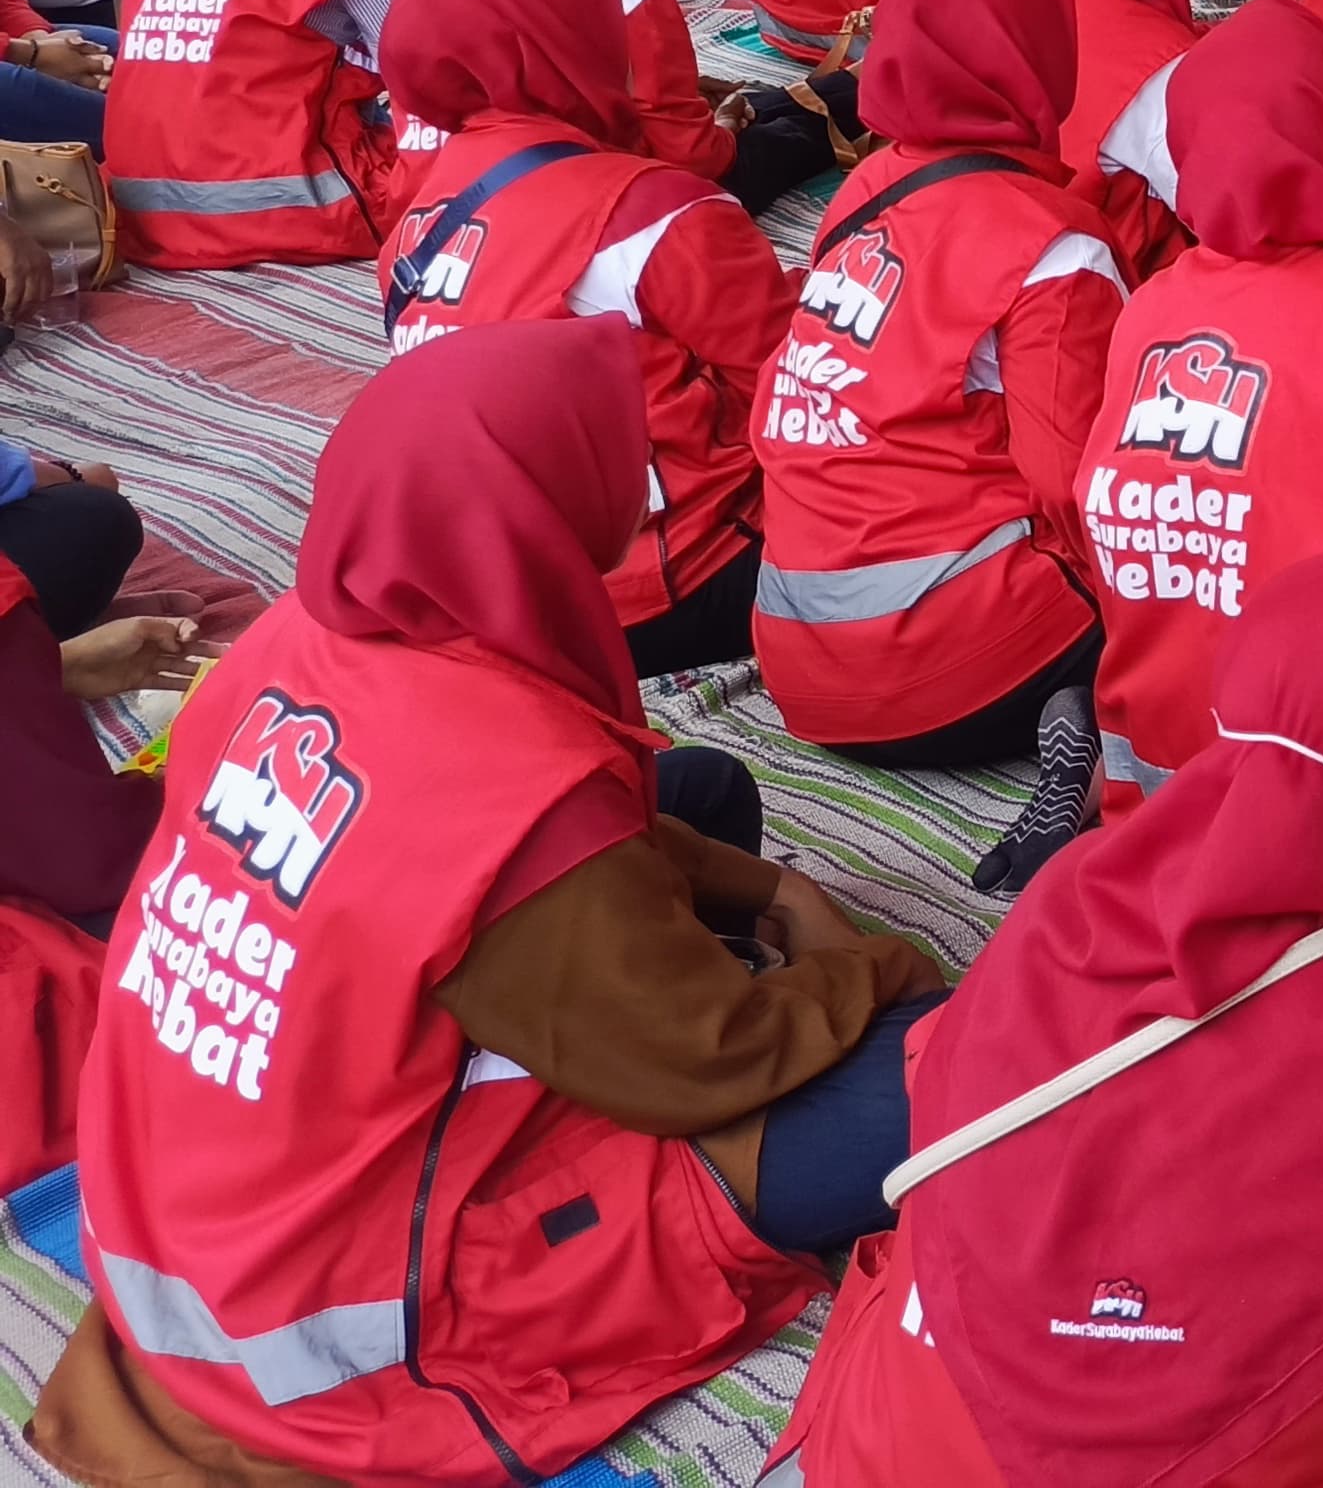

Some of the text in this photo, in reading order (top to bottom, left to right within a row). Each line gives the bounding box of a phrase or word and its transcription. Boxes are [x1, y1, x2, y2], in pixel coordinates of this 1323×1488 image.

[777, 327, 868, 392] ader
[1085, 467, 1251, 532] Kader
[1086, 514, 1247, 565] Surabaya
